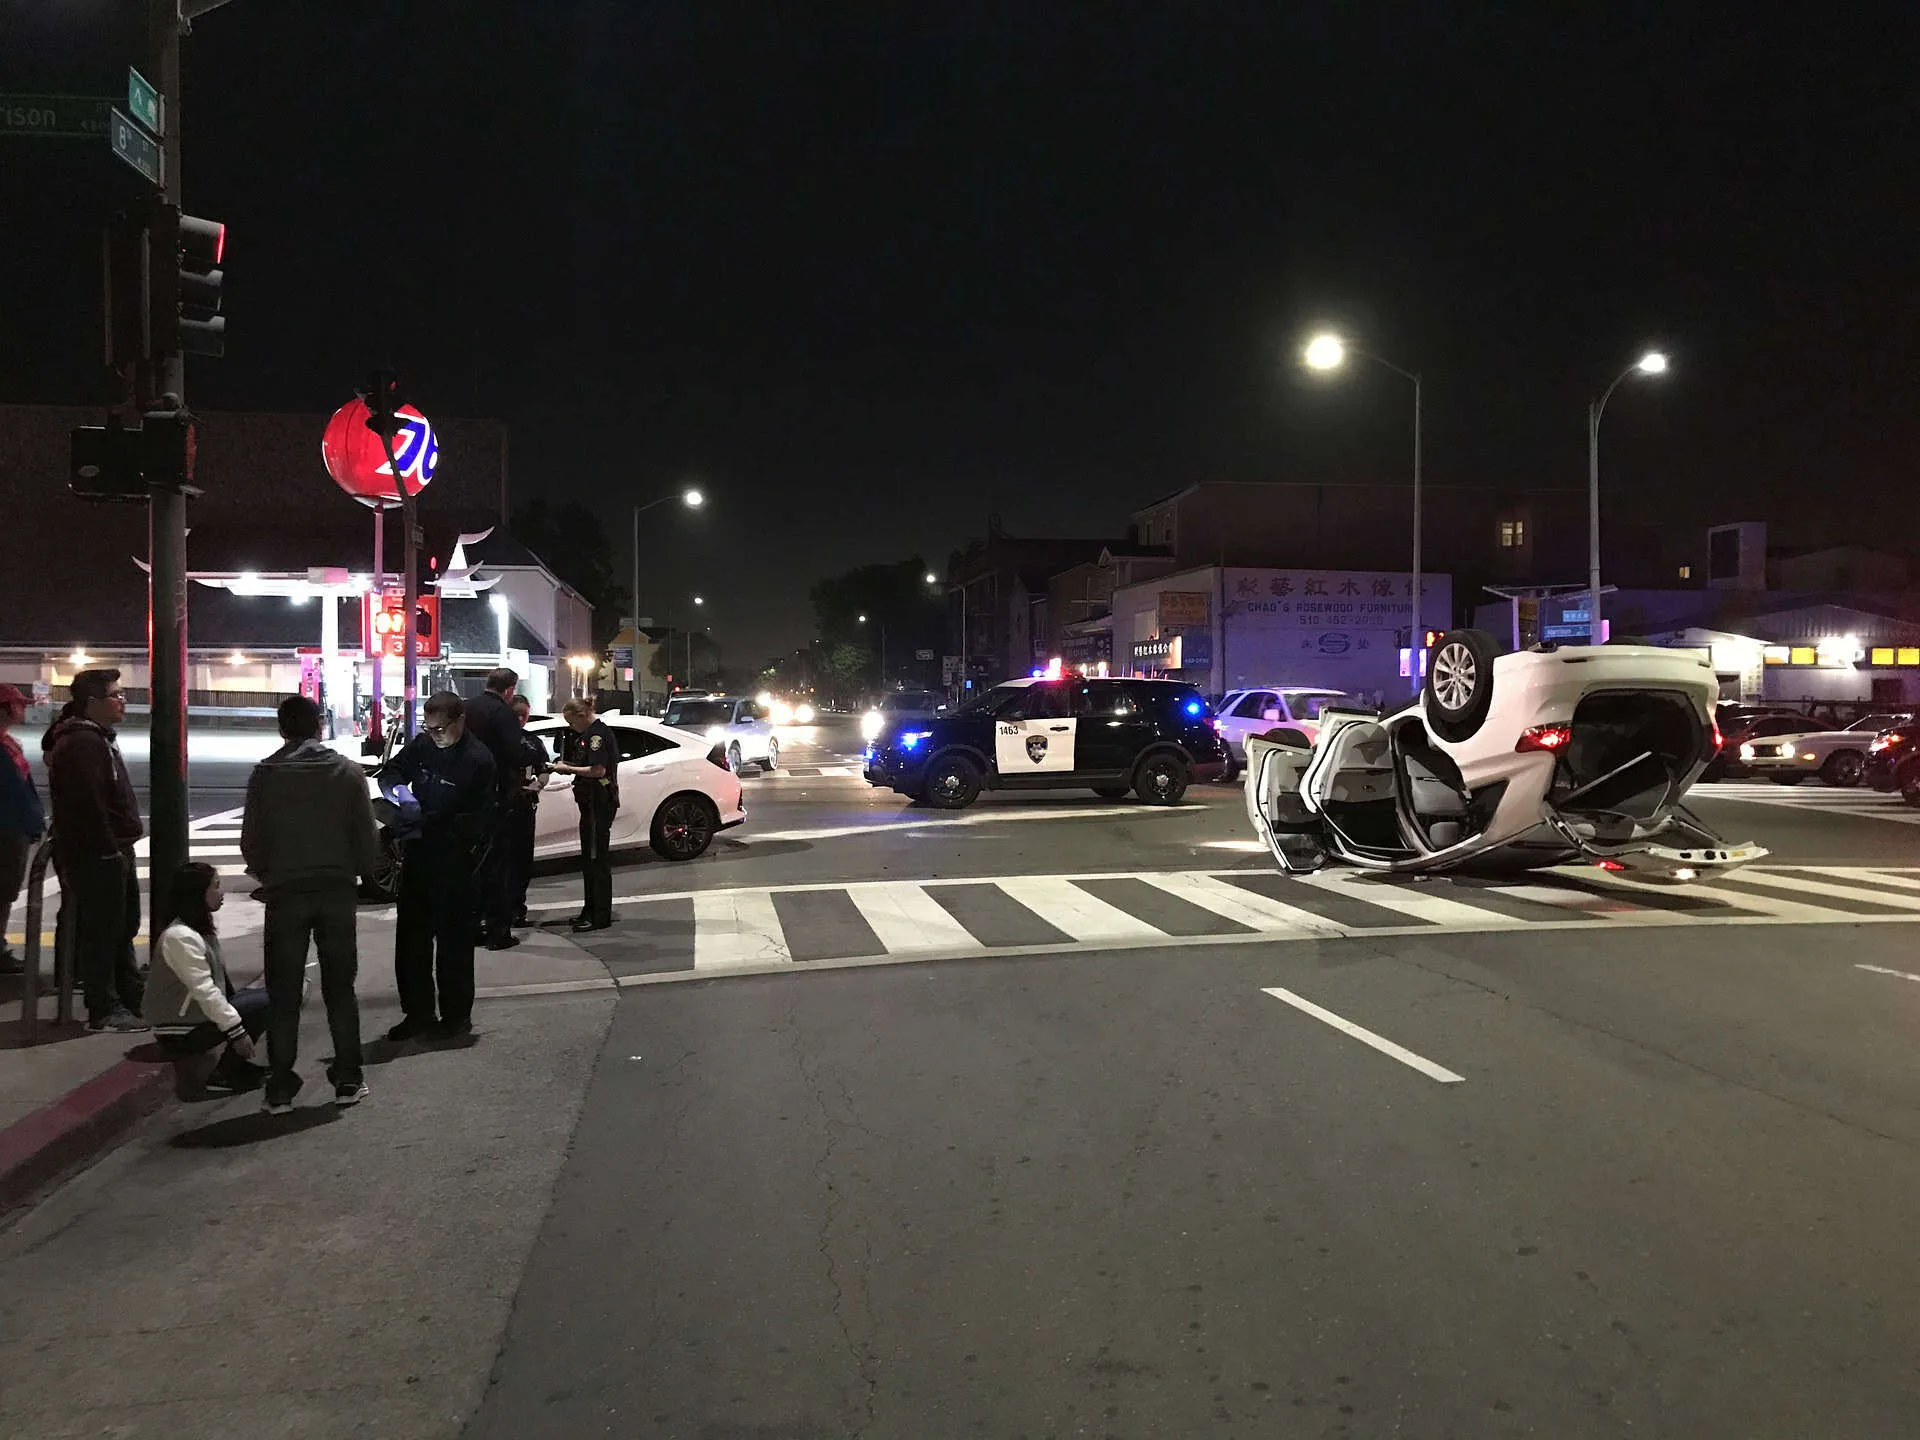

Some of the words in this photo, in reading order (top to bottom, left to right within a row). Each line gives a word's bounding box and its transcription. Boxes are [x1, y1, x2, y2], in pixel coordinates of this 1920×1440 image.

[1296, 602, 1353, 613] ROSEWOOD
[1359, 602, 1413, 614] FURNITUR
[999, 725, 1019, 736] 1463
